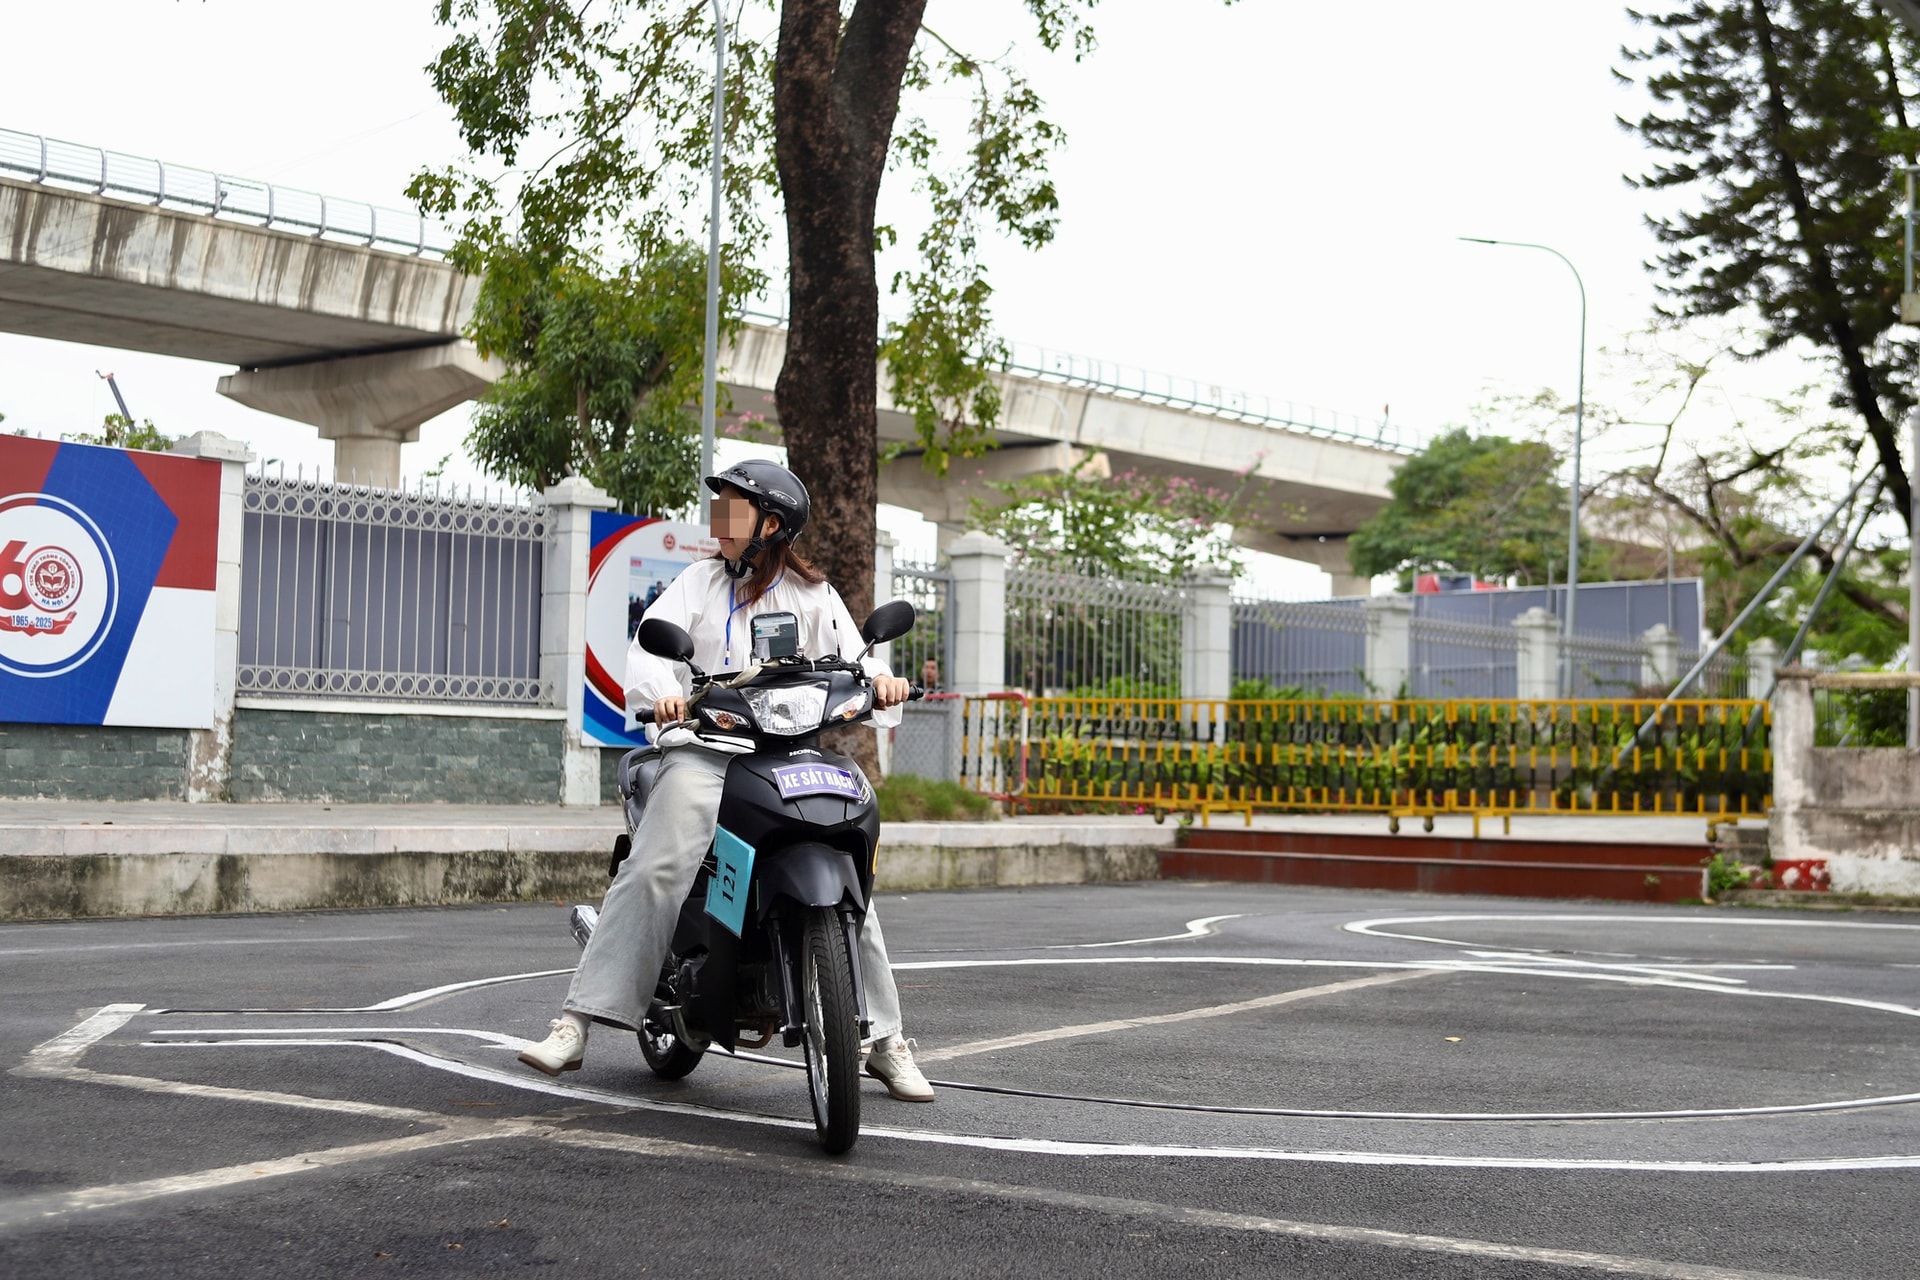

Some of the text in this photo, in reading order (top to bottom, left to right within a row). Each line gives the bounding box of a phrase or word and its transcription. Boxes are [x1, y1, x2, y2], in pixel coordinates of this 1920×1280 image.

[12, 615, 29, 627] 1965
[35, 616, 53, 628] 2025
[788, 748, 823, 757] HONDA
[782, 768, 856, 790] XE SÁT HẠCH
[722, 862, 737, 906] 121
